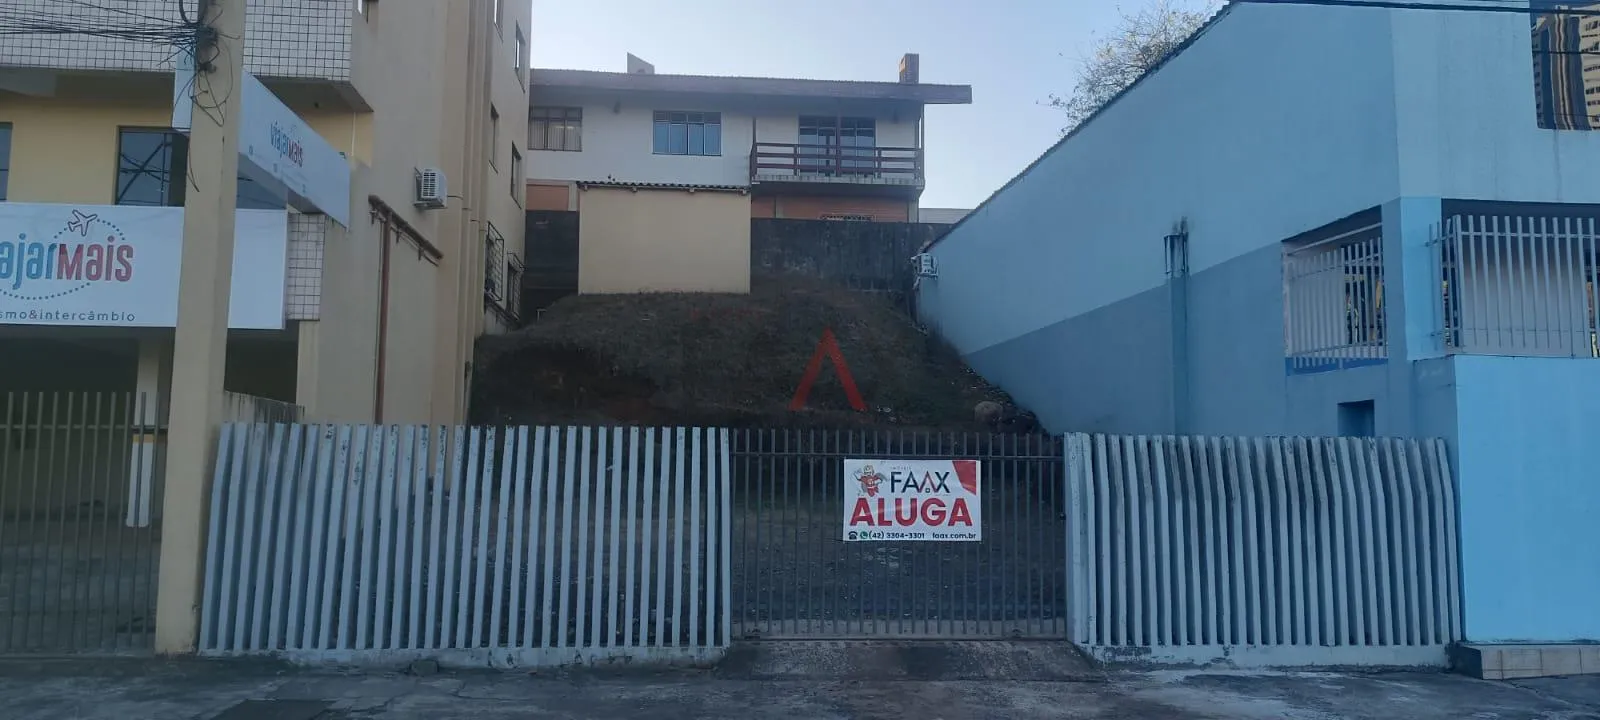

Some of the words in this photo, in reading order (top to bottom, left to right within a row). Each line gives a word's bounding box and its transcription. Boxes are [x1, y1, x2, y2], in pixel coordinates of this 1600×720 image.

[849, 497, 973, 527] ALUGA
[868, 531, 885, 540] (42)
[932, 532, 977, 540] faax.com.br
